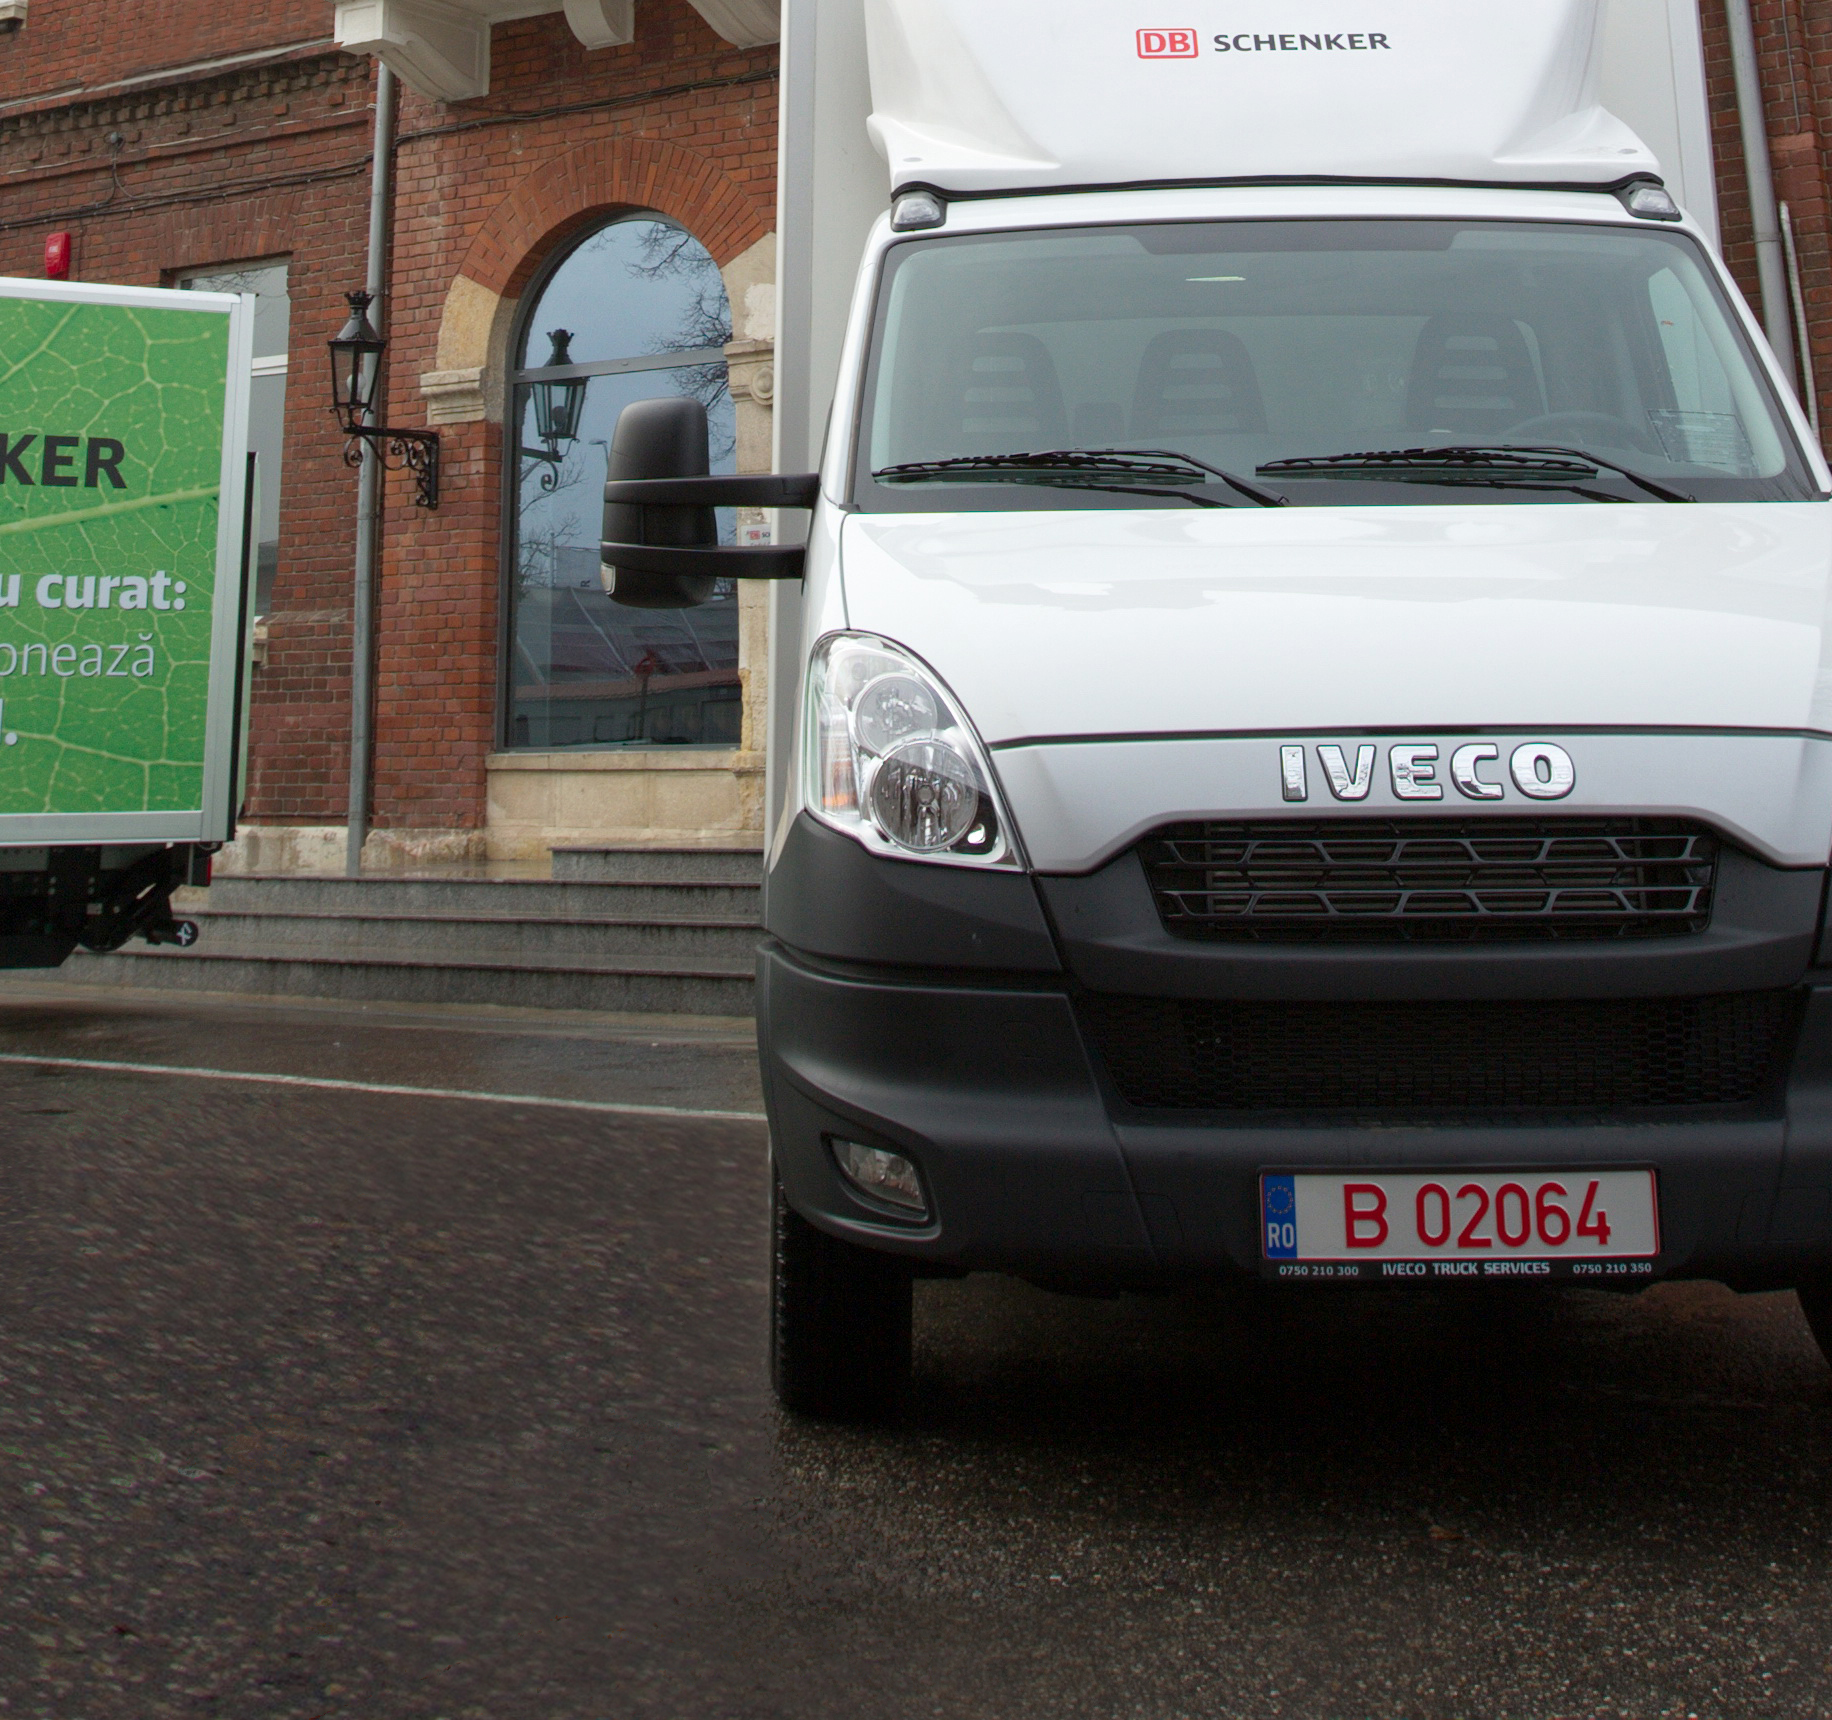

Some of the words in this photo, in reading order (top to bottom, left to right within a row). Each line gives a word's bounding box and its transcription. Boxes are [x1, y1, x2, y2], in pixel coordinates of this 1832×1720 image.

[1143, 32, 1191, 53] DB
[1214, 33, 1391, 52] SCHENKER
[35, 570, 187, 611] curat:
[1280, 742, 1576, 802] IVECO
[1343, 1183, 1389, 1249] B
[1415, 1180, 1612, 1249] 02064
[1268, 1223, 1295, 1249] RO
[1279, 1265, 1308, 1276] 0750
[1312, 1265, 1334, 1276] 210
[1337, 1265, 1359, 1276] 300
[1382, 1262, 1426, 1276] IVECO
[1432, 1262, 1478, 1276] TRUCK
[1483, 1261, 1550, 1275] SERVICES
[1572, 1264, 1602, 1274] 0750
[1606, 1263, 1627, 1274] 210
[1630, 1263, 1652, 1273] 350
